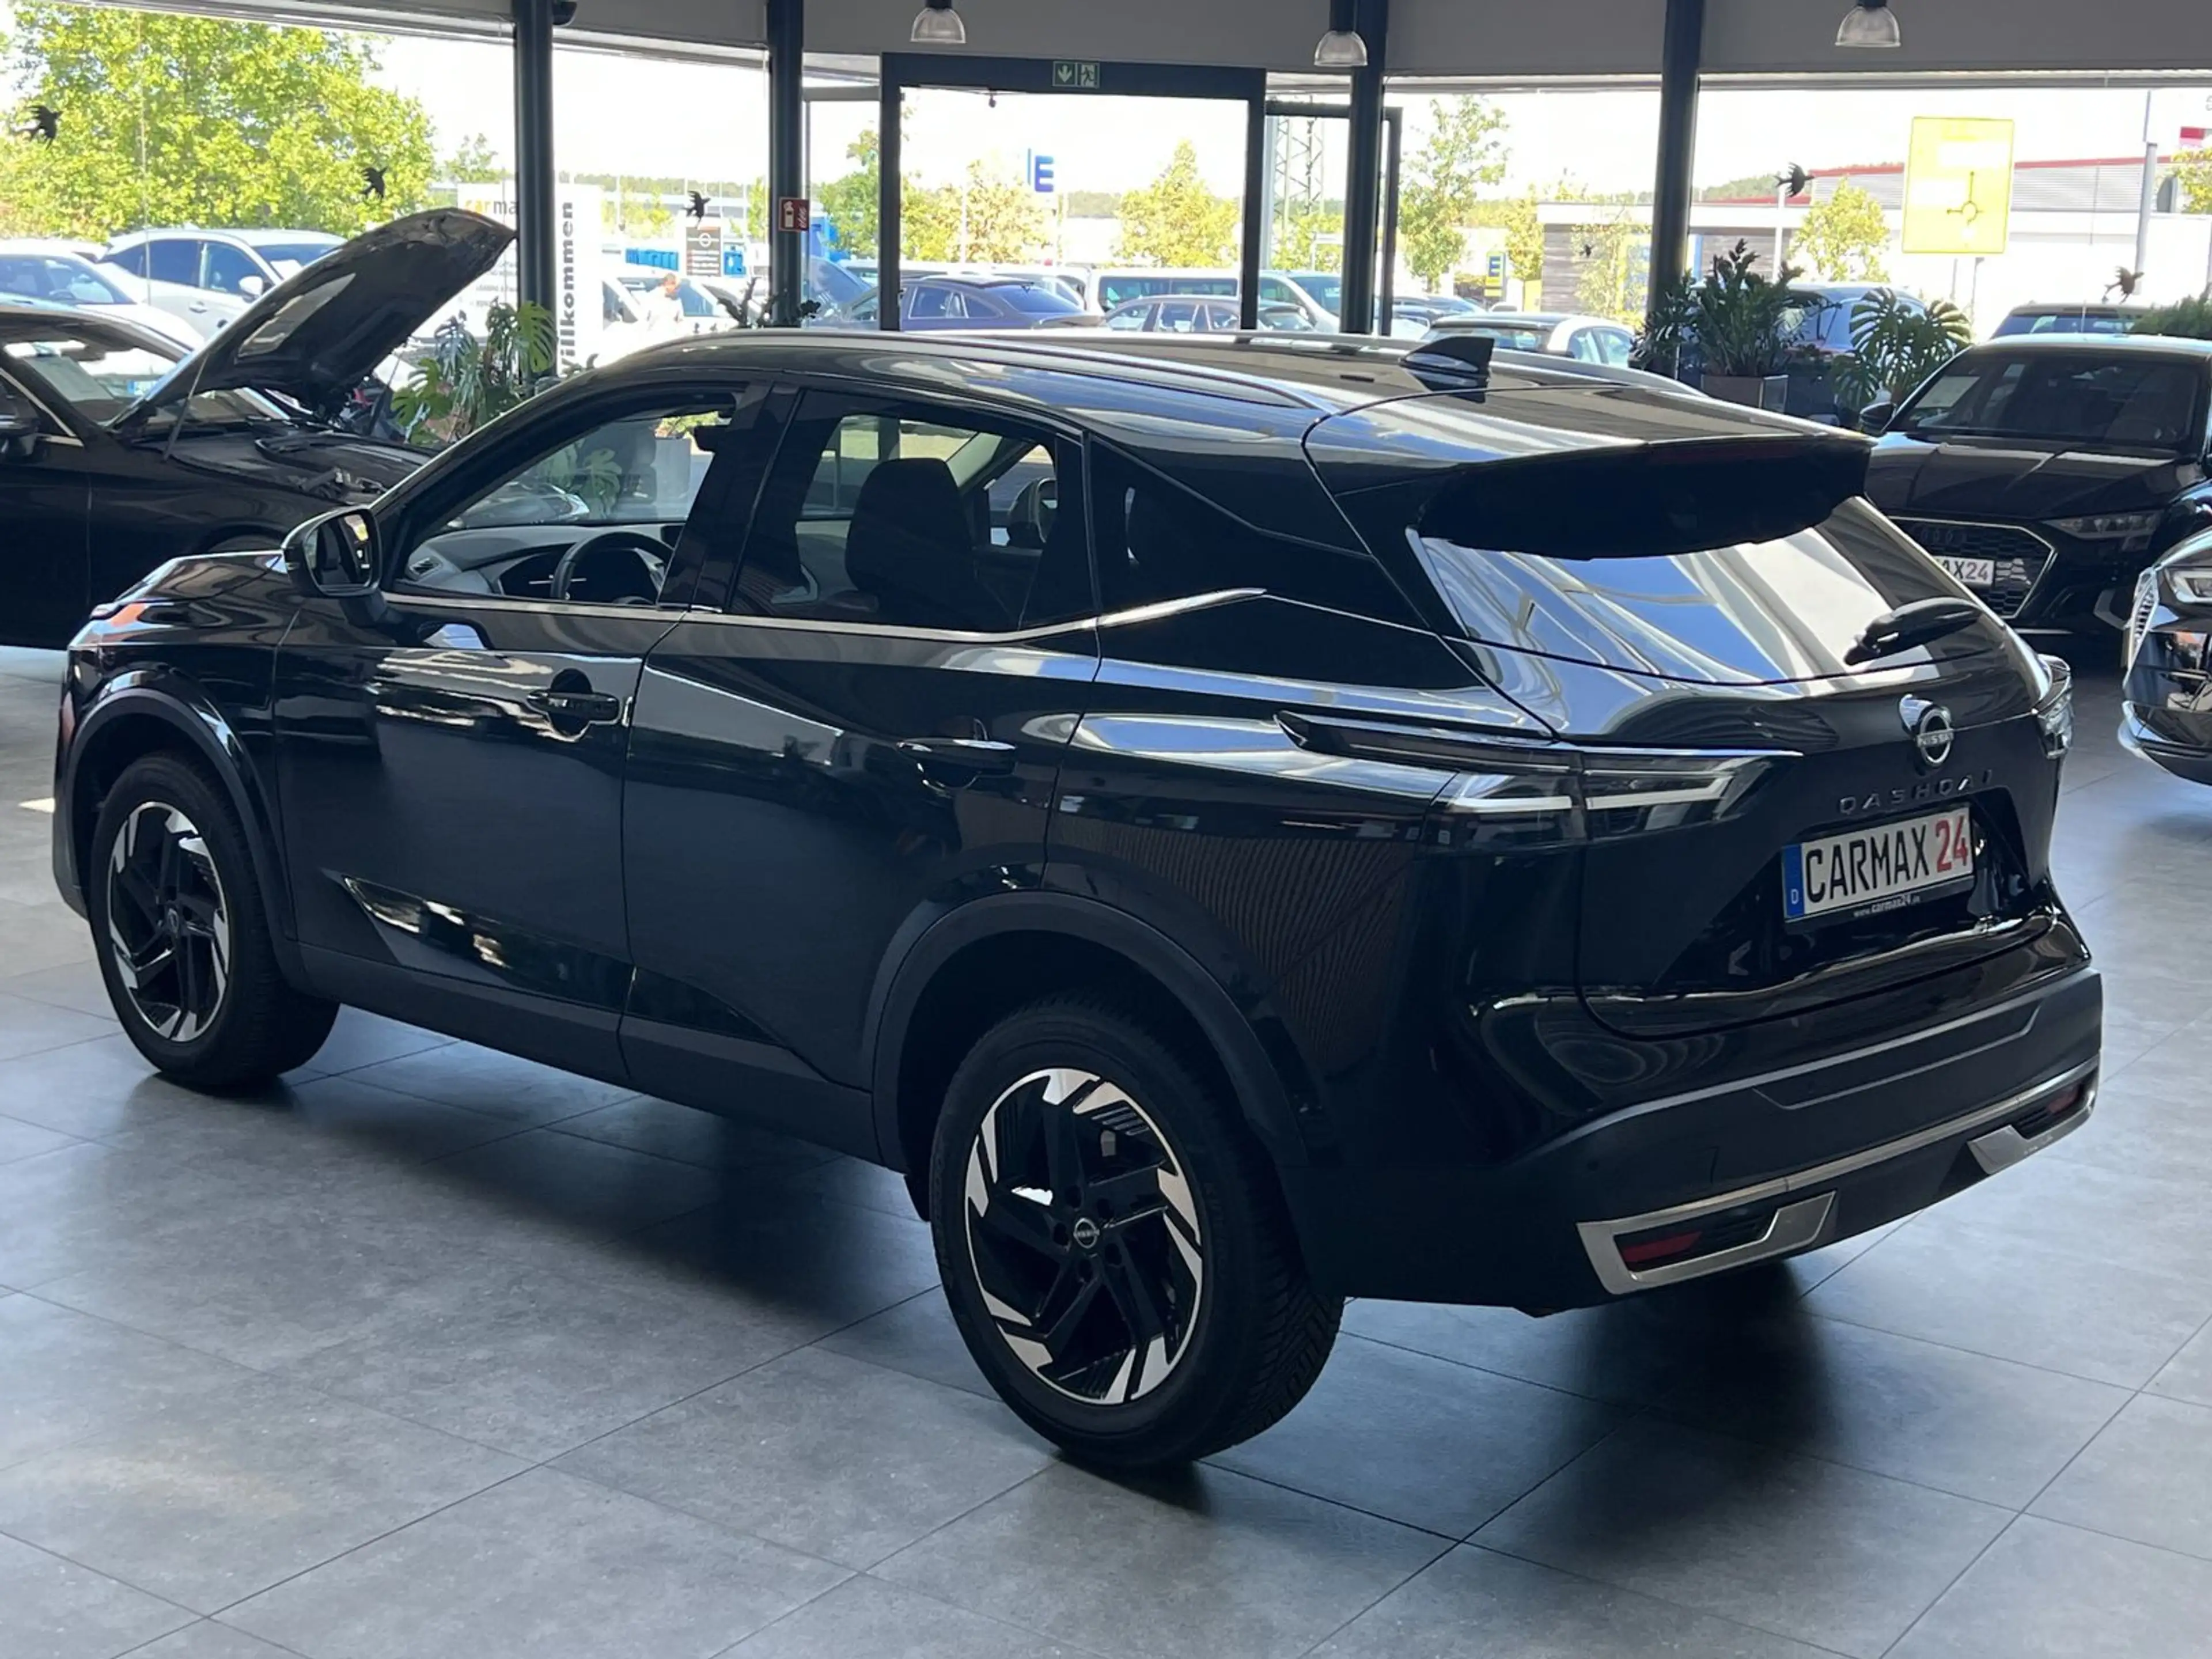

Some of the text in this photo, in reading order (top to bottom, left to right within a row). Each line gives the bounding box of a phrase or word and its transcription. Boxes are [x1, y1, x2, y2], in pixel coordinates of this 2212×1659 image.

[1035, 156, 1054, 192] E
[465, 199, 517, 215] carma
[1936, 559, 1988, 581] AX24
[1917, 731, 1953, 747] NISSAN
[1839, 768, 1992, 815] QASHQAI
[1790, 889, 1799, 904] D
